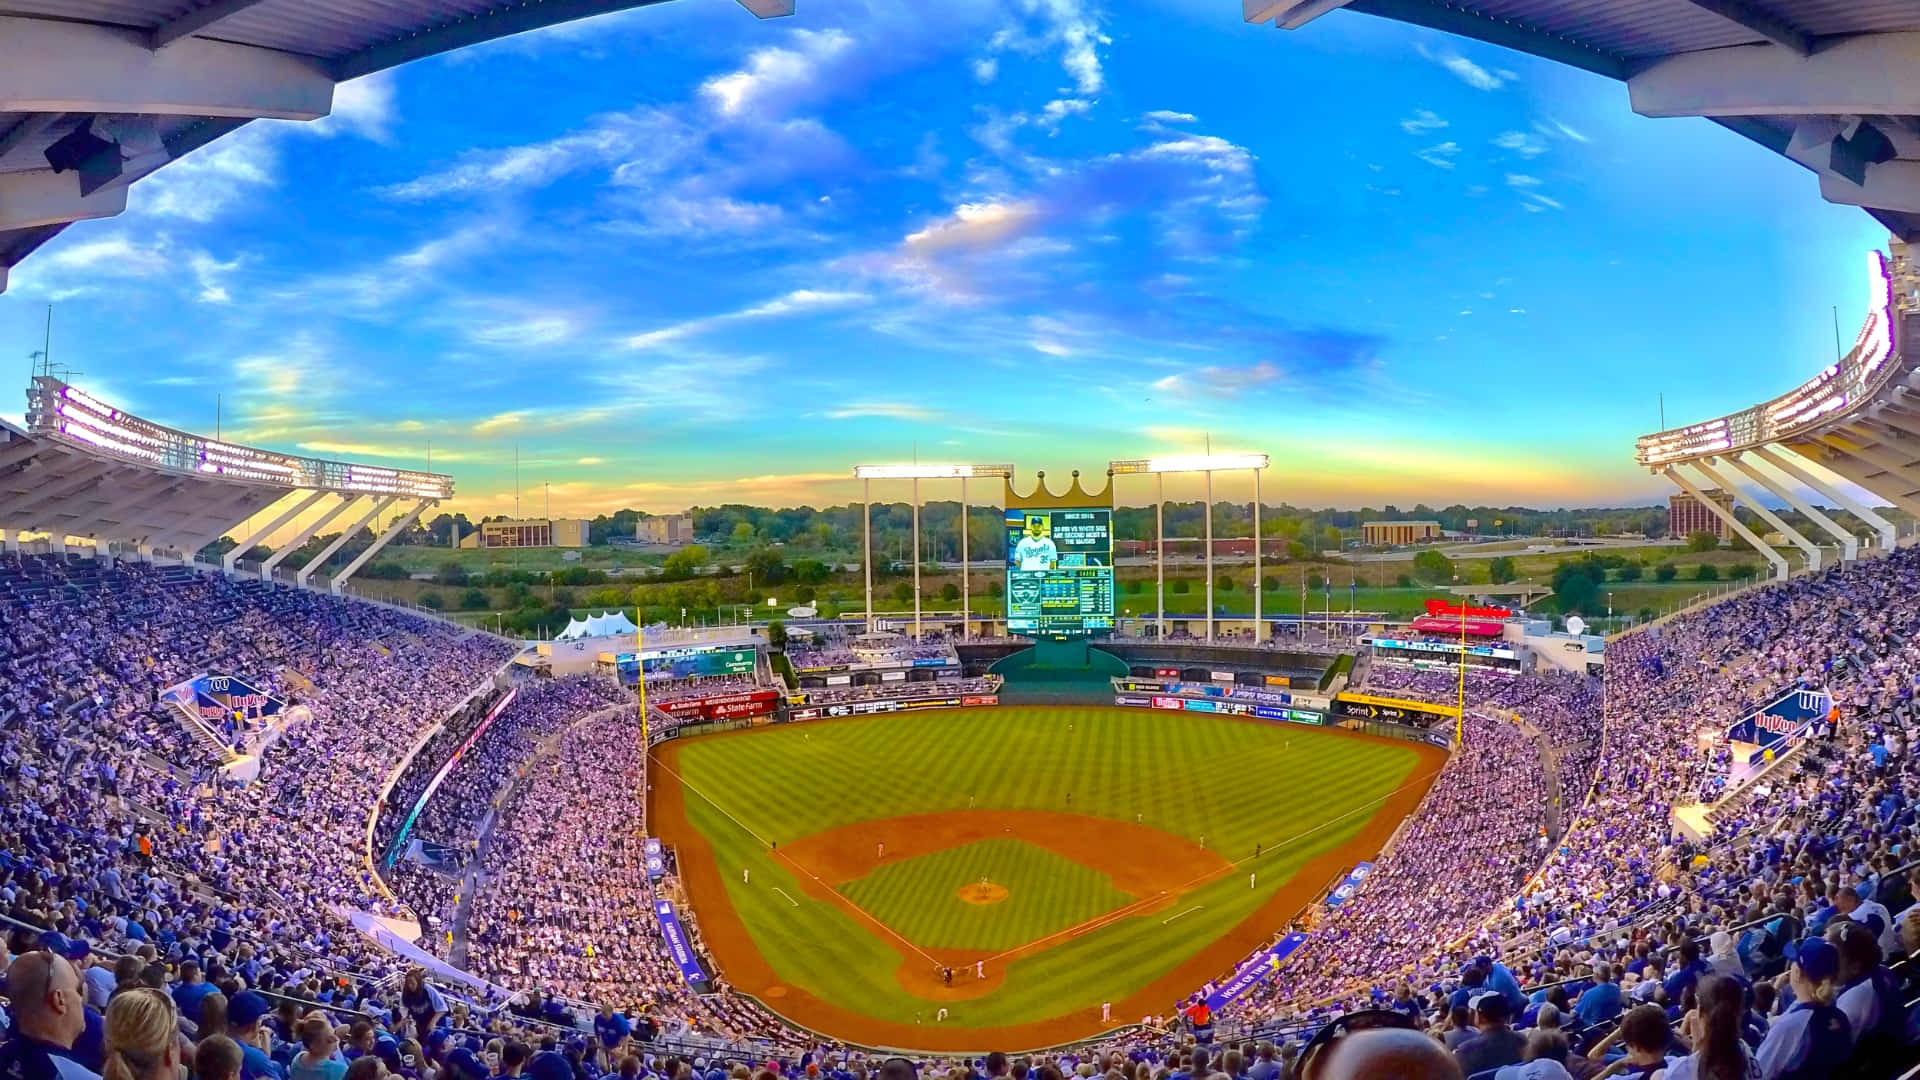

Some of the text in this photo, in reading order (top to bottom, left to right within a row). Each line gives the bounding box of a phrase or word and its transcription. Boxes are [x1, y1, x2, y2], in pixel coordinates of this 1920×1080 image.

[1256, 692, 1282, 703] PORCH
[727, 702, 763, 712] State Farm
[1346, 705, 1369, 716] Sprint
[1755, 713, 1796, 732] HyVee
[1220, 982, 1245, 999] HOME
[1241, 974, 1254, 983] OF
